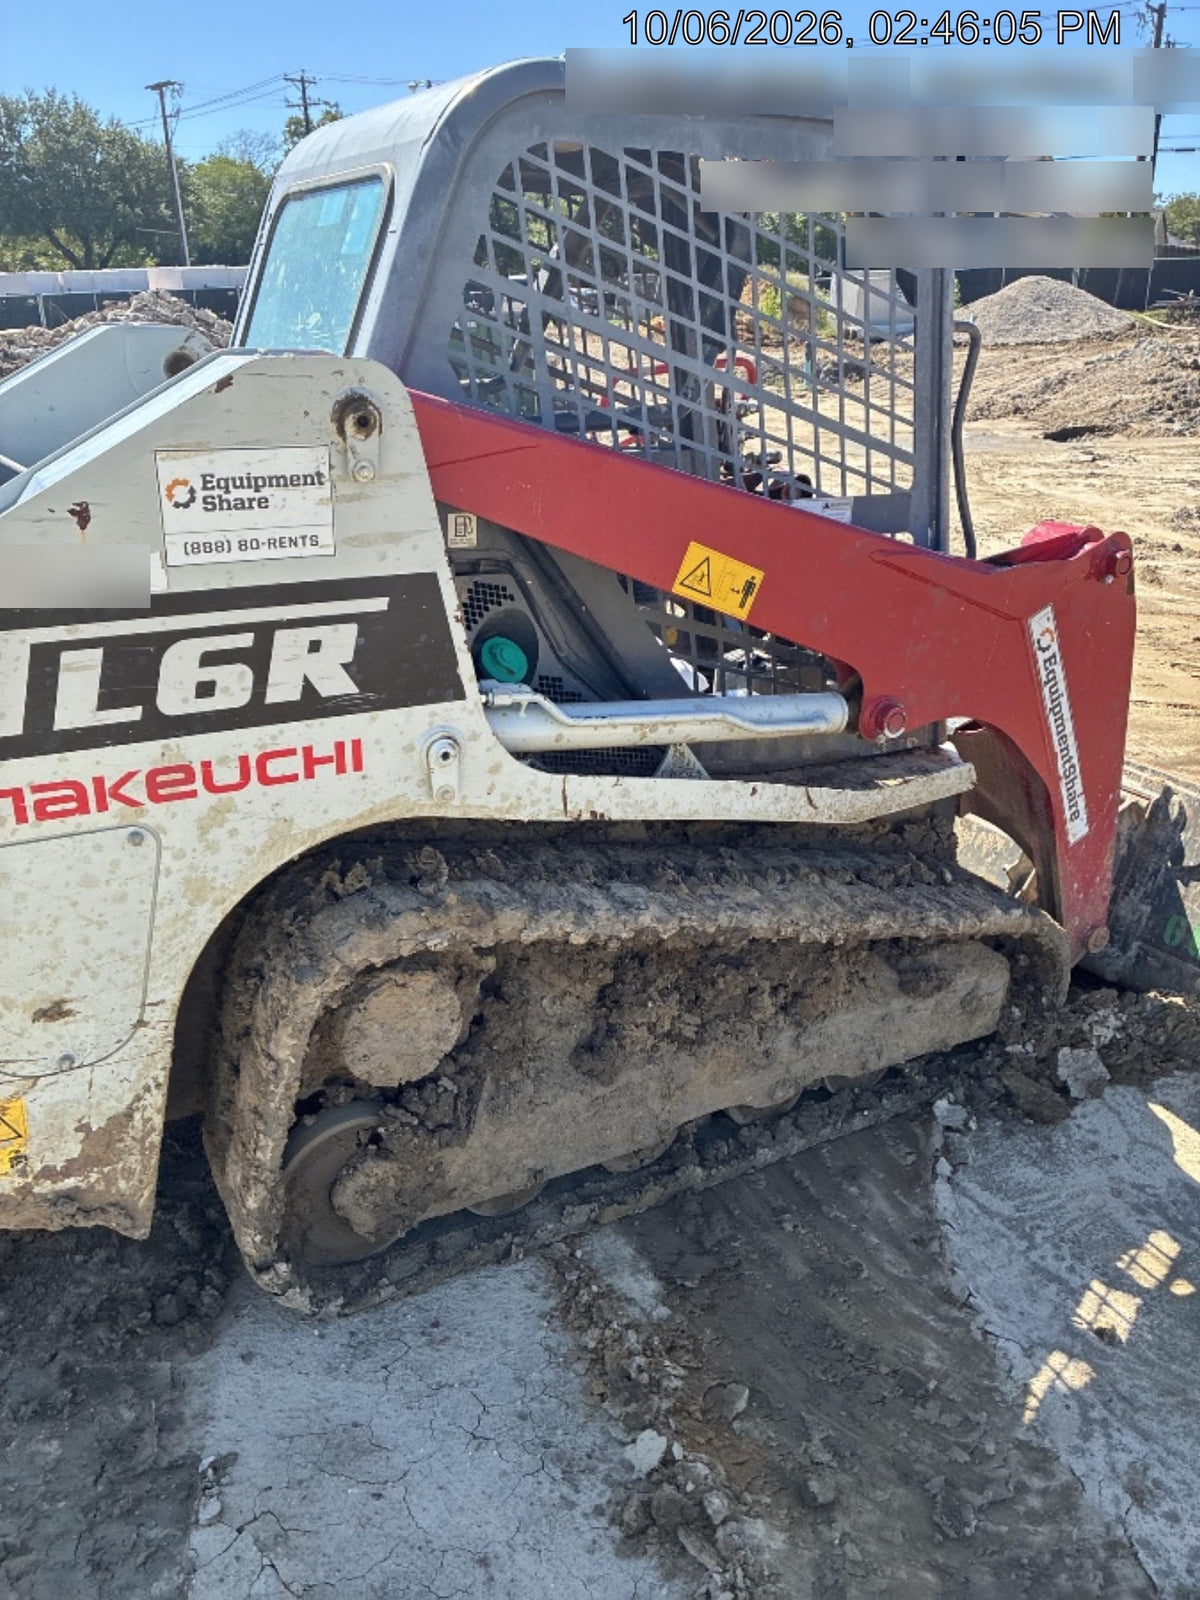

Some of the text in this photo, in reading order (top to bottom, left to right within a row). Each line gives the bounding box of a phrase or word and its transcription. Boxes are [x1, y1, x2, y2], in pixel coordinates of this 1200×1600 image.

[200, 470, 325, 494] Equipment
[202, 494, 270, 513] Share
[184, 534, 319, 556] (888) 80-RENTS
[1042, 652, 1080, 823] EquipmentShare
